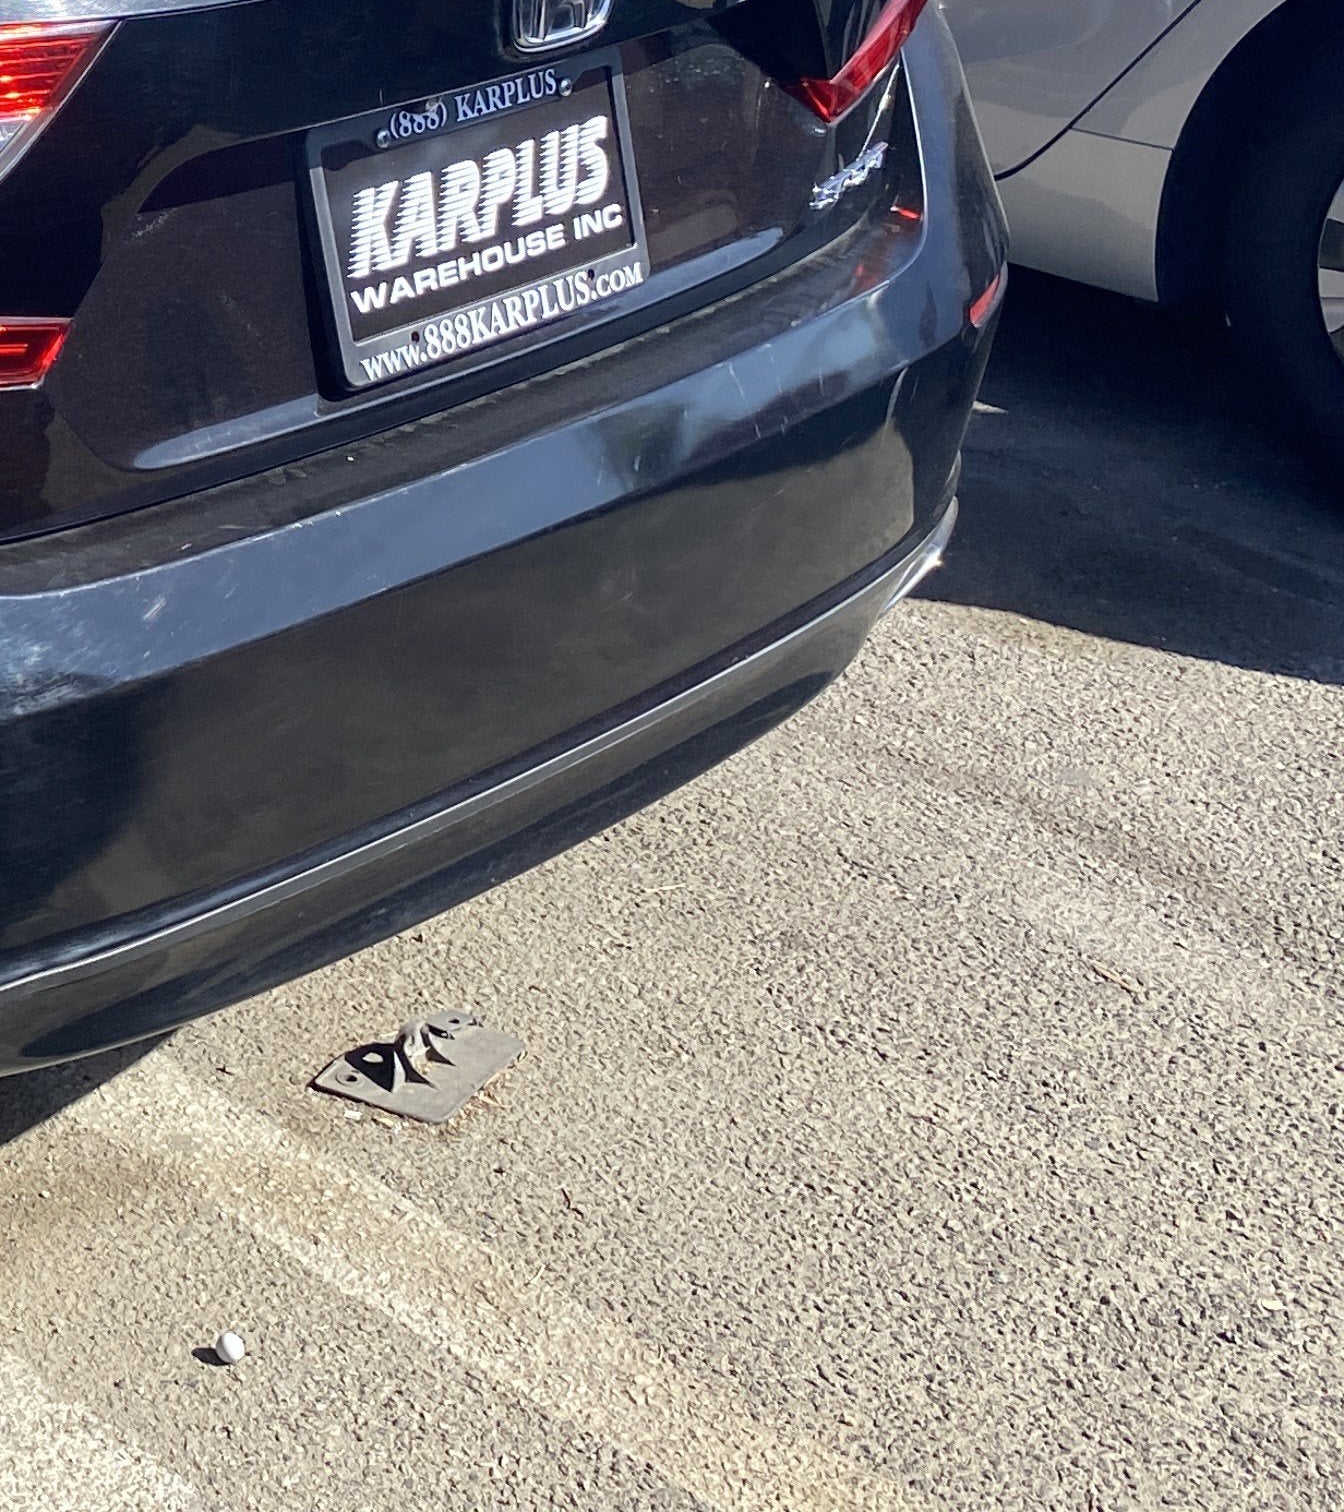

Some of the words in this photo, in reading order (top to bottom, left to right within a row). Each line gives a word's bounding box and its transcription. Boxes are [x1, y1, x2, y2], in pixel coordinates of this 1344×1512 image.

[389, 101, 447, 139] (888)
[454, 69, 556, 122] KARPLUS
[347, 115, 609, 279] KARPLUS
[350, 225, 565, 314] WAREHOUSE
[573, 204, 623, 240] INC
